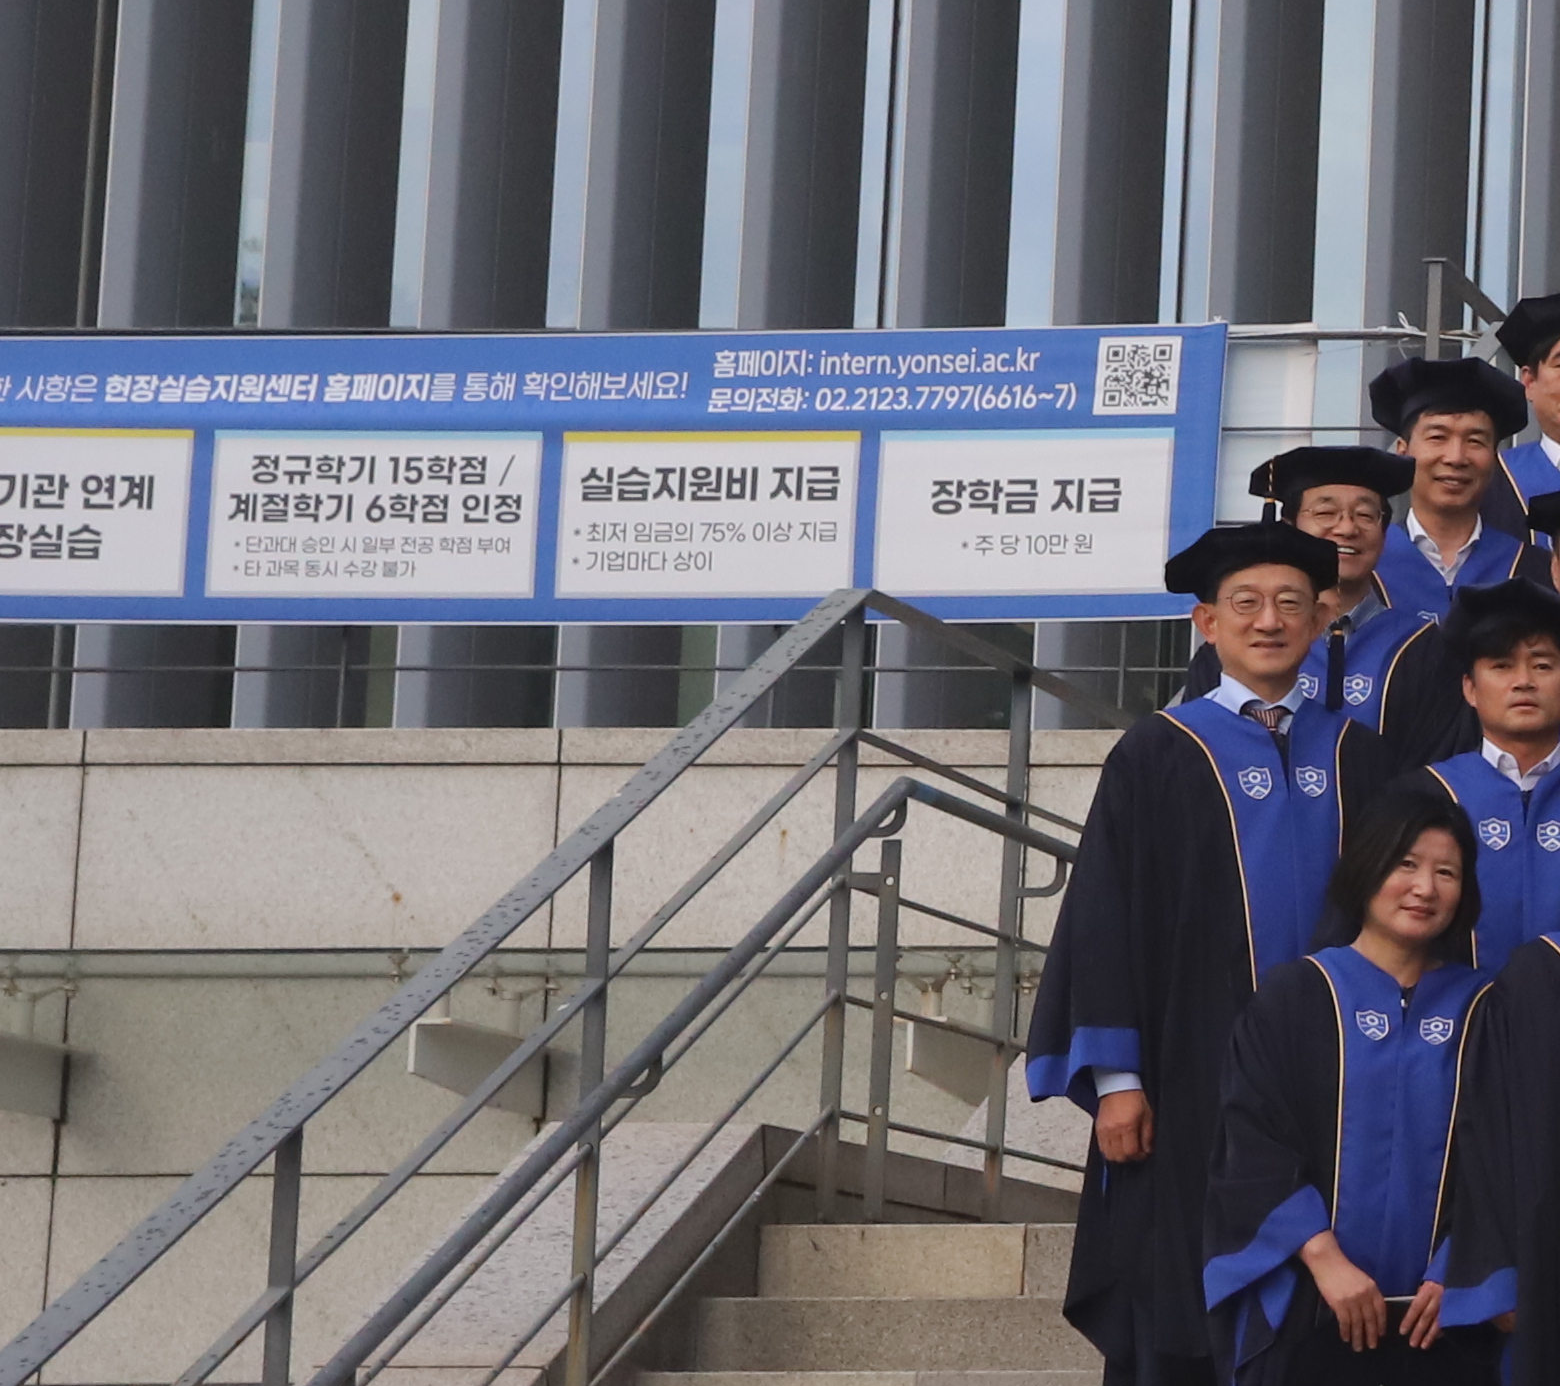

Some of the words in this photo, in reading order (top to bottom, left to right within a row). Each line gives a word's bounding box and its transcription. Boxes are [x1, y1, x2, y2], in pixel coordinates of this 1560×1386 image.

[713, 350, 813, 379] 홈페이지:
[819, 347, 1040, 379] intern.yonsei.ac.kr
[15, 374, 98, 403] 사항은
[104, 373, 318, 403] 현장실습지원센터
[323, 372, 456, 403] 홈페이지를
[463, 372, 516, 401] 통해
[523, 371, 688, 401] 확인해보세요!
[707, 387, 810, 413] 문의전화:
[814, 382, 1078, 411] 02.2123.7797(6616~7)
[251, 455, 376, 485] 정규학기
[389, 456, 488, 485] 15학점
[580, 466, 759, 502] 실습지원비
[769, 466, 841, 502] 지급
[81, 475, 154, 510] 연계
[931, 478, 1038, 515] 장학금
[1050, 477, 1122, 513] 지급
[228, 494, 353, 523] 계절학기
[365, 494, 448, 523] 6학점
[461, 494, 523, 524] 인정
[245, 537, 297, 554] 단과대
[301, 537, 335, 554] 승인
[341, 538, 357, 554] 시
[361, 537, 396, 555] 일부
[400, 537, 434, 555] 전공
[439, 537, 473, 555] 학점
[477, 537, 511, 555] 부여
[585, 522, 628, 544] 최저
[632, 522, 694, 544] 임금의
[699, 523, 747, 544] 75%
[752, 522, 793, 543] 이상
[797, 521, 838, 543] 지급
[974, 535, 995, 556] 주
[1000, 535, 1020, 555] 당
[1025, 534, 1069, 555] 10만
[1073, 533, 1093, 554] 원
[244, 561, 261, 578] 타
[265, 560, 299, 578] 과목
[304, 561, 338, 578] 동시
[343, 561, 376, 578] 수강
[381, 560, 416, 578] 불가
[585, 550, 669, 572] 기업마다
[672, 551, 713, 572] 상이
